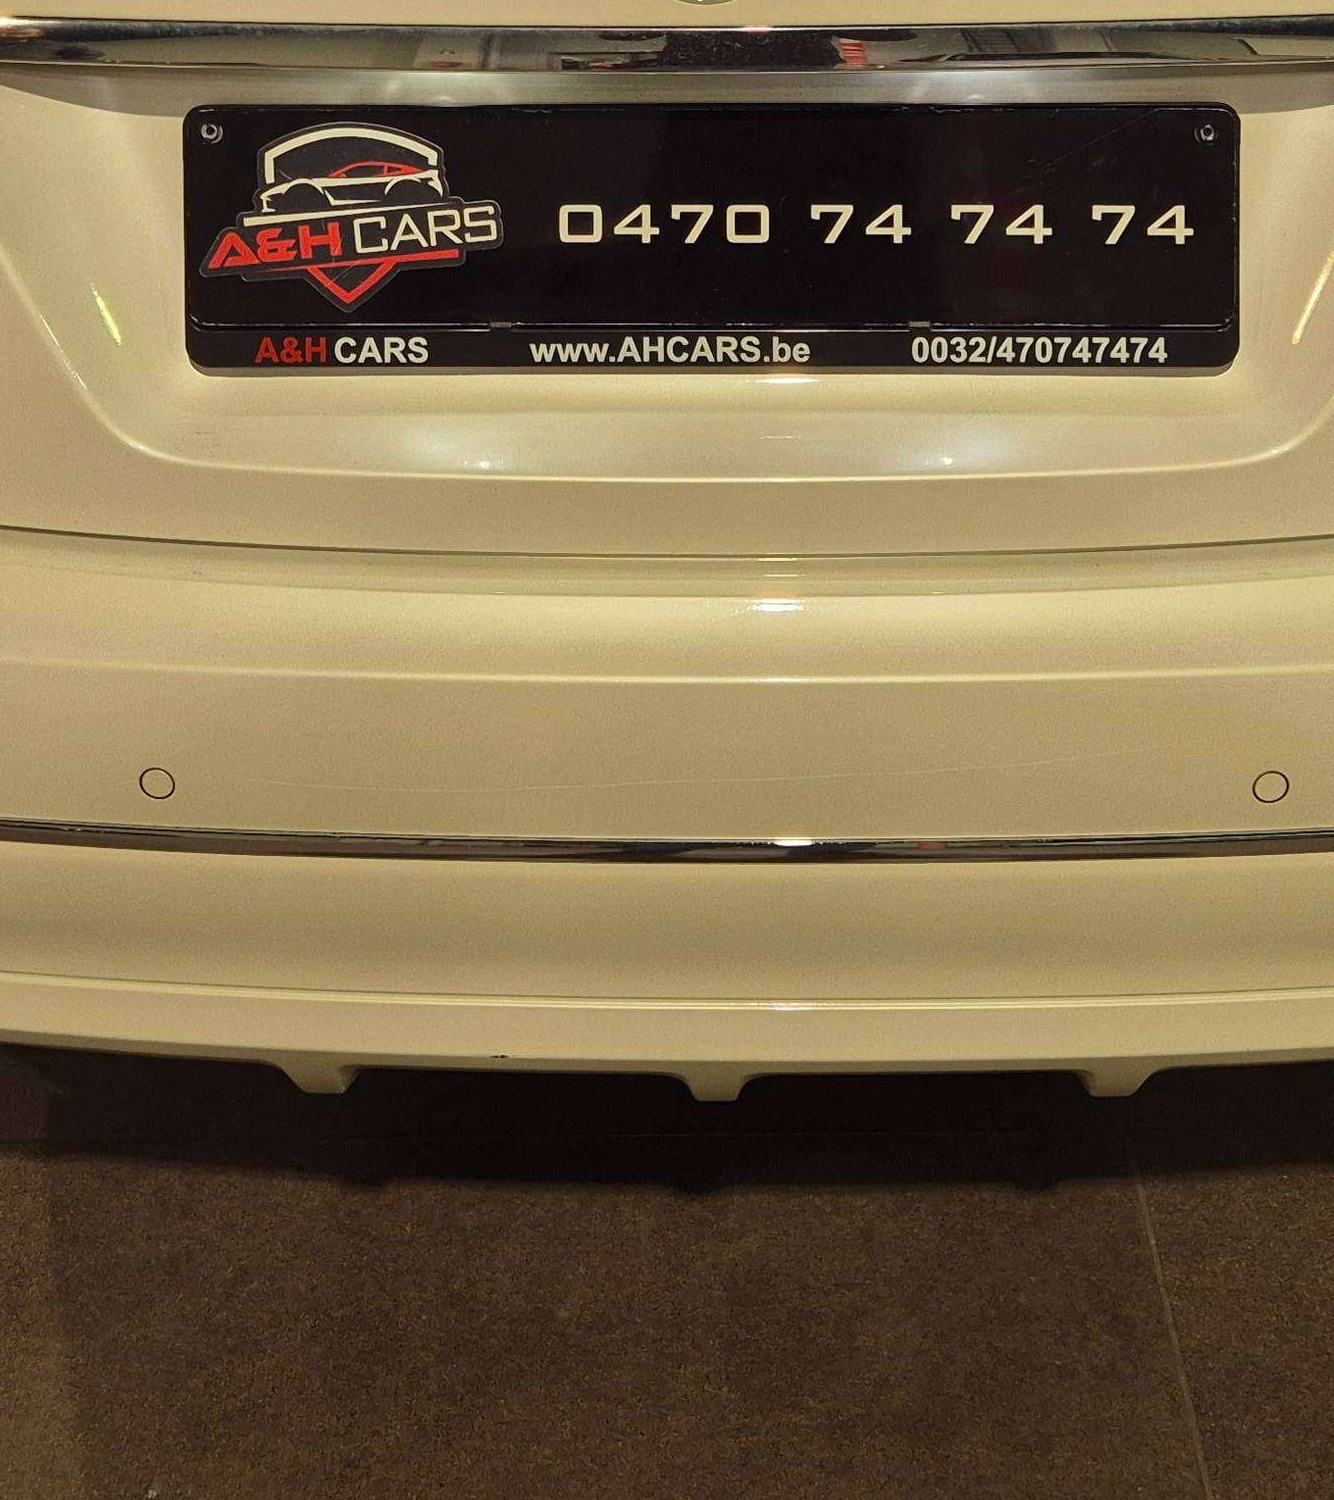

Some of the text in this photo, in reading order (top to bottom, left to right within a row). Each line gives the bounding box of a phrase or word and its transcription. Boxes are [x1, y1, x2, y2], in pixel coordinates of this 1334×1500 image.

[206, 204, 498, 269] A&H CARS
[559, 204, 1194, 245] 0470 74 74 74
[254, 336, 429, 364] A&H CARS
[529, 336, 811, 363] www.AHCARS.be
[911, 336, 1168, 364] 0032/470747474
